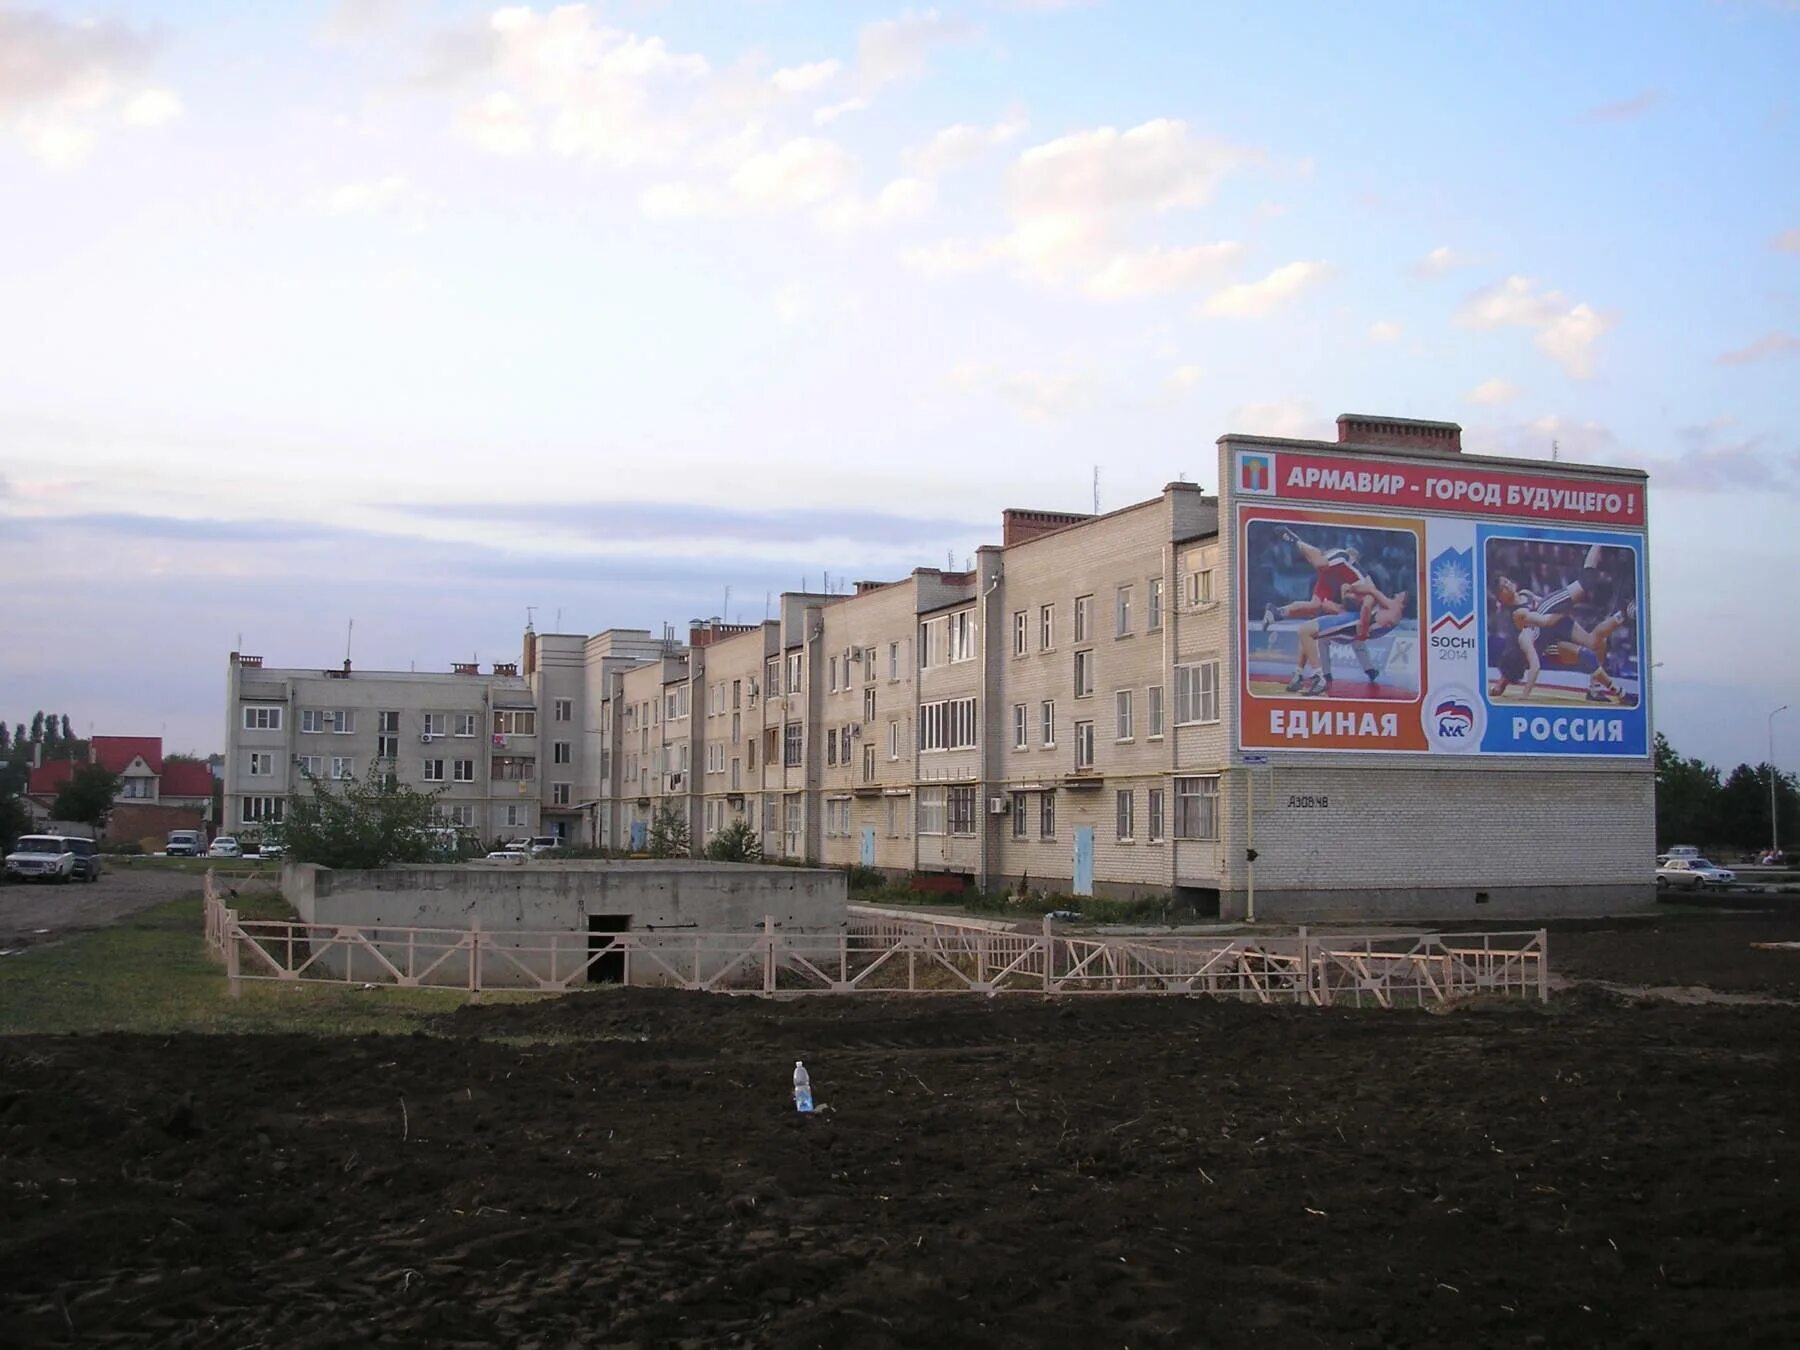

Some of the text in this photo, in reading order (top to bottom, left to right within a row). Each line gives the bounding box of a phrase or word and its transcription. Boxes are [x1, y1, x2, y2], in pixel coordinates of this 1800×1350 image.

[1286, 466, 1405, 495] АРМАВИР
[1425, 478, 1501, 507] ГОРОД
[1507, 485, 1622, 513] БУДУЩЕГО
[1431, 636, 1475, 649] SOCHI
[1439, 649, 1468, 661] 2014
[1270, 709, 1398, 739] ЕДИНАЯ
[1512, 716, 1623, 742] РОССИЯ
